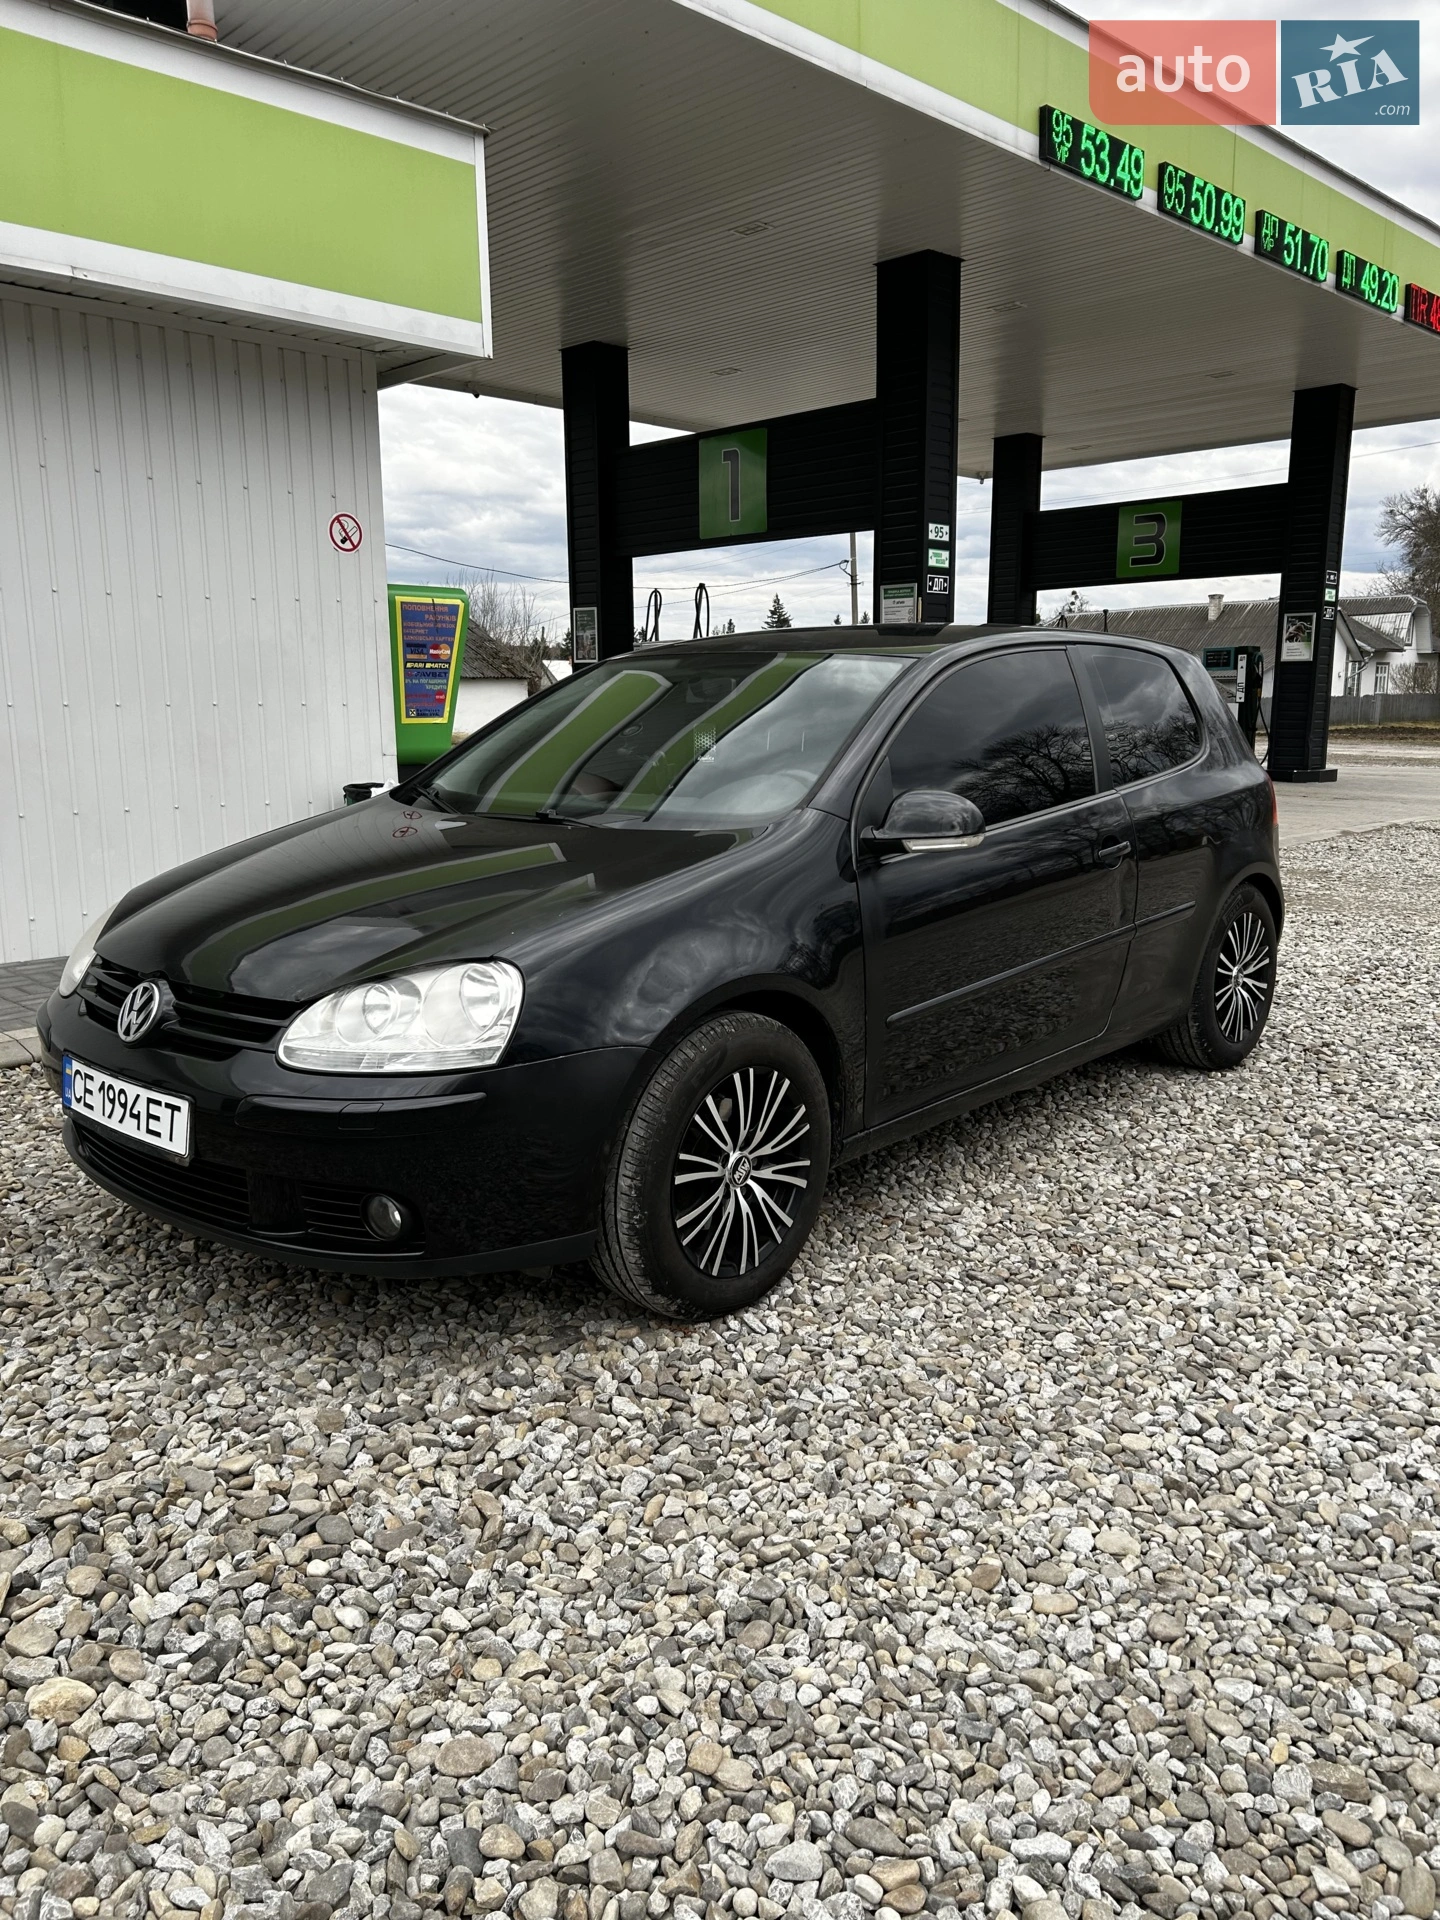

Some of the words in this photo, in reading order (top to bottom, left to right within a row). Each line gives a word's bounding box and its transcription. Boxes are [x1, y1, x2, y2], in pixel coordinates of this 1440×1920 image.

[1052, 109, 1073, 149] 95
[1080, 123, 1144, 198] 53.49
[1055, 143, 1069, 164] VIP
[1164, 165, 1186, 214] 95
[1190, 176, 1245, 243] 50.99
[1262, 237, 1275, 252] VIP
[1262, 212, 1279, 239] ДП
[1283, 222, 1329, 281] 51.70
[1341, 251, 1356, 289] ДП
[1360, 262, 1400, 313] 49.20
[1411, 283, 1428, 325] TIR
[720, 447, 741, 523] 1
[934, 525, 944, 539] 95
[1129, 512, 1168, 569] 3
[402, 604, 449, 613] ПОПОВНЕННЯ
[932, 578, 944, 592] ДП
